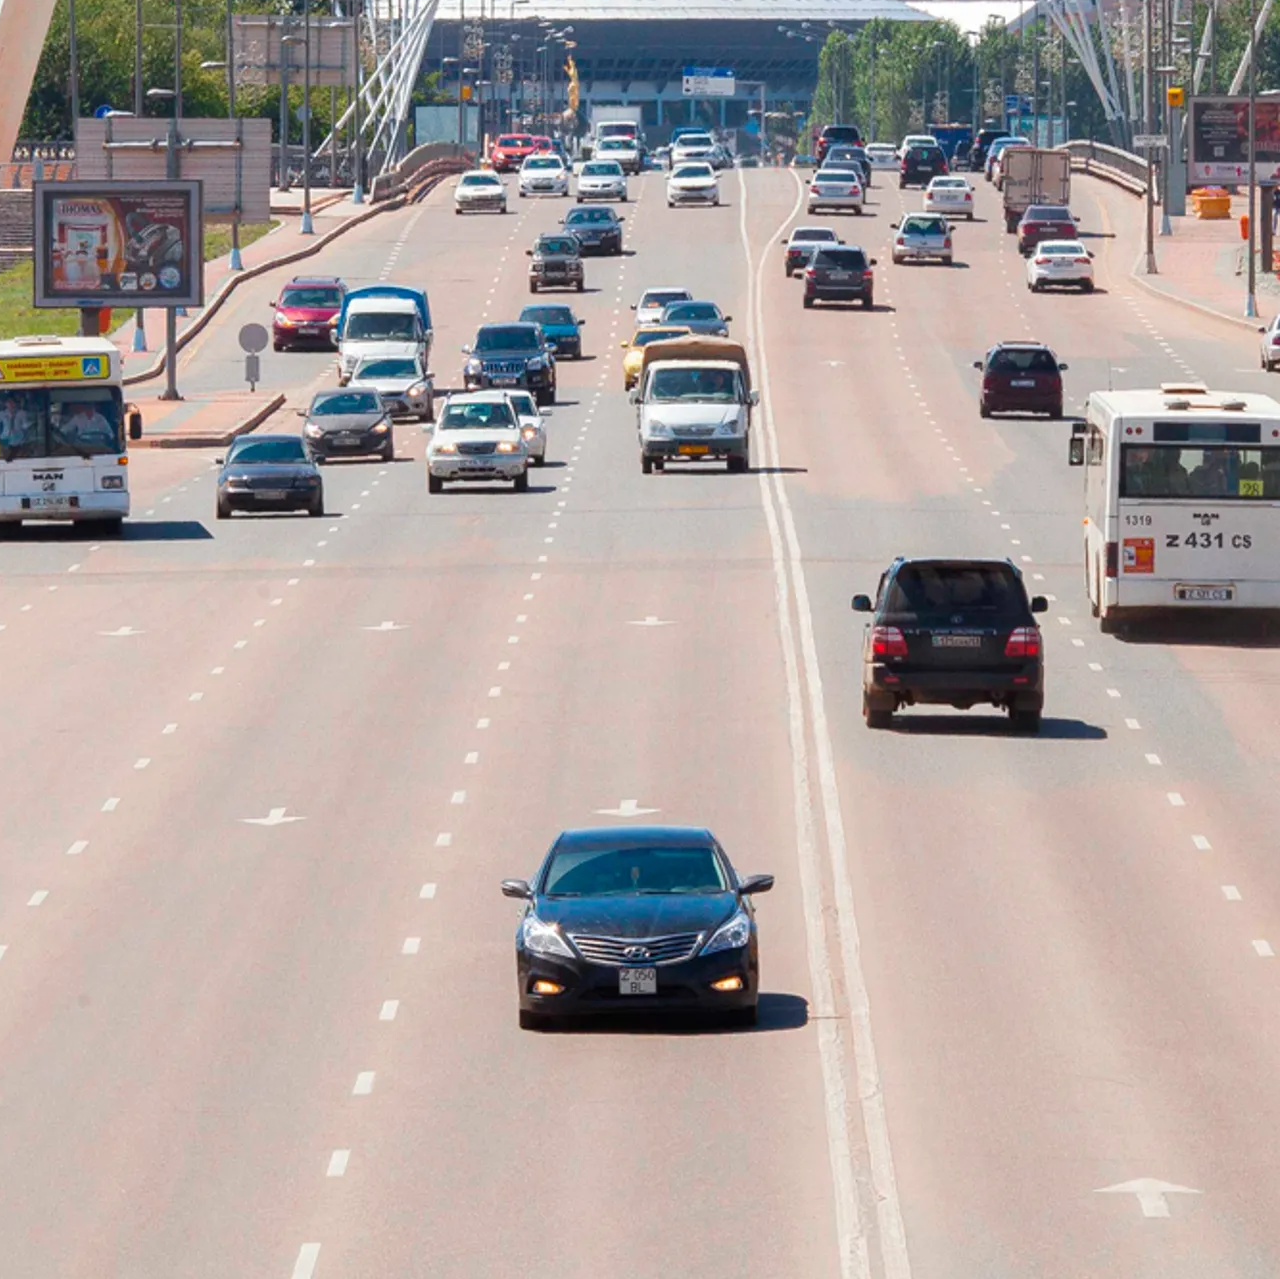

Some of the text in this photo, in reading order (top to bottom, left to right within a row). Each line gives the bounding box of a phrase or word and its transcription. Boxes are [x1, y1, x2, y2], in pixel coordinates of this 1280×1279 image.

[32, 473, 64, 481] MAN
[1125, 515, 1152, 526] 1319
[1166, 532, 1253, 549] Z 431 CS
